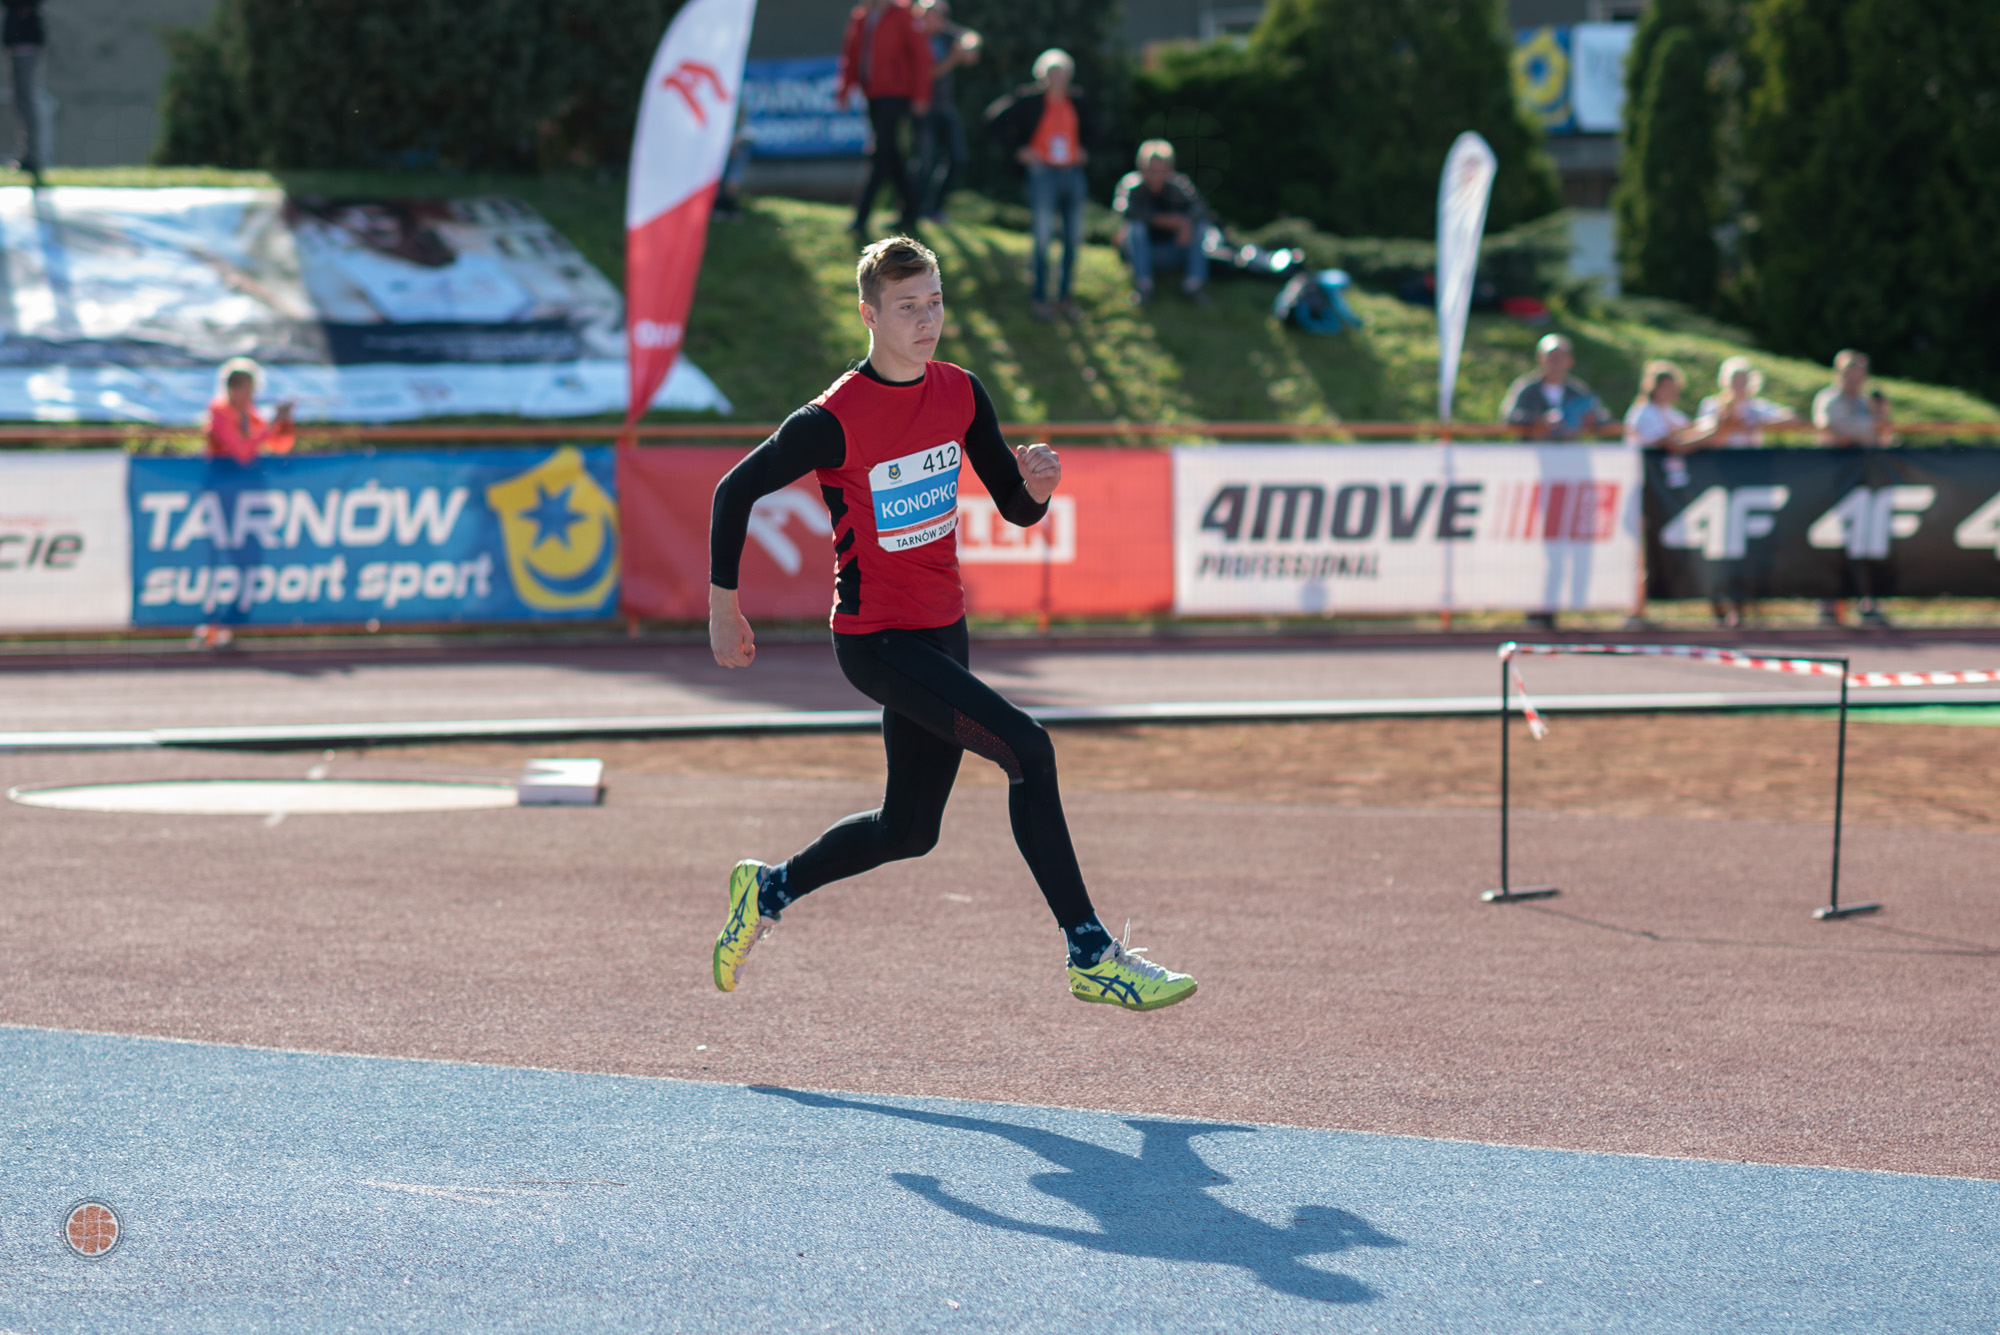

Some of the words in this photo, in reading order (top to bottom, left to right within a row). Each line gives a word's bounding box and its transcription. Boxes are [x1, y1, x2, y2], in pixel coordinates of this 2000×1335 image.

[923, 446, 957, 473] 412
[140, 479, 468, 549] TARNÓW
[881, 481, 957, 518] KONOPKO
[1199, 484, 1482, 540] 4MOVE
[1660, 485, 1790, 560] 4F
[1807, 485, 1937, 560] 4F
[896, 528, 937, 548] TARNÓW
[1197, 553, 1378, 577] PROFESSIONAL
[139, 554, 346, 613] support
[356, 553, 492, 608] sport
